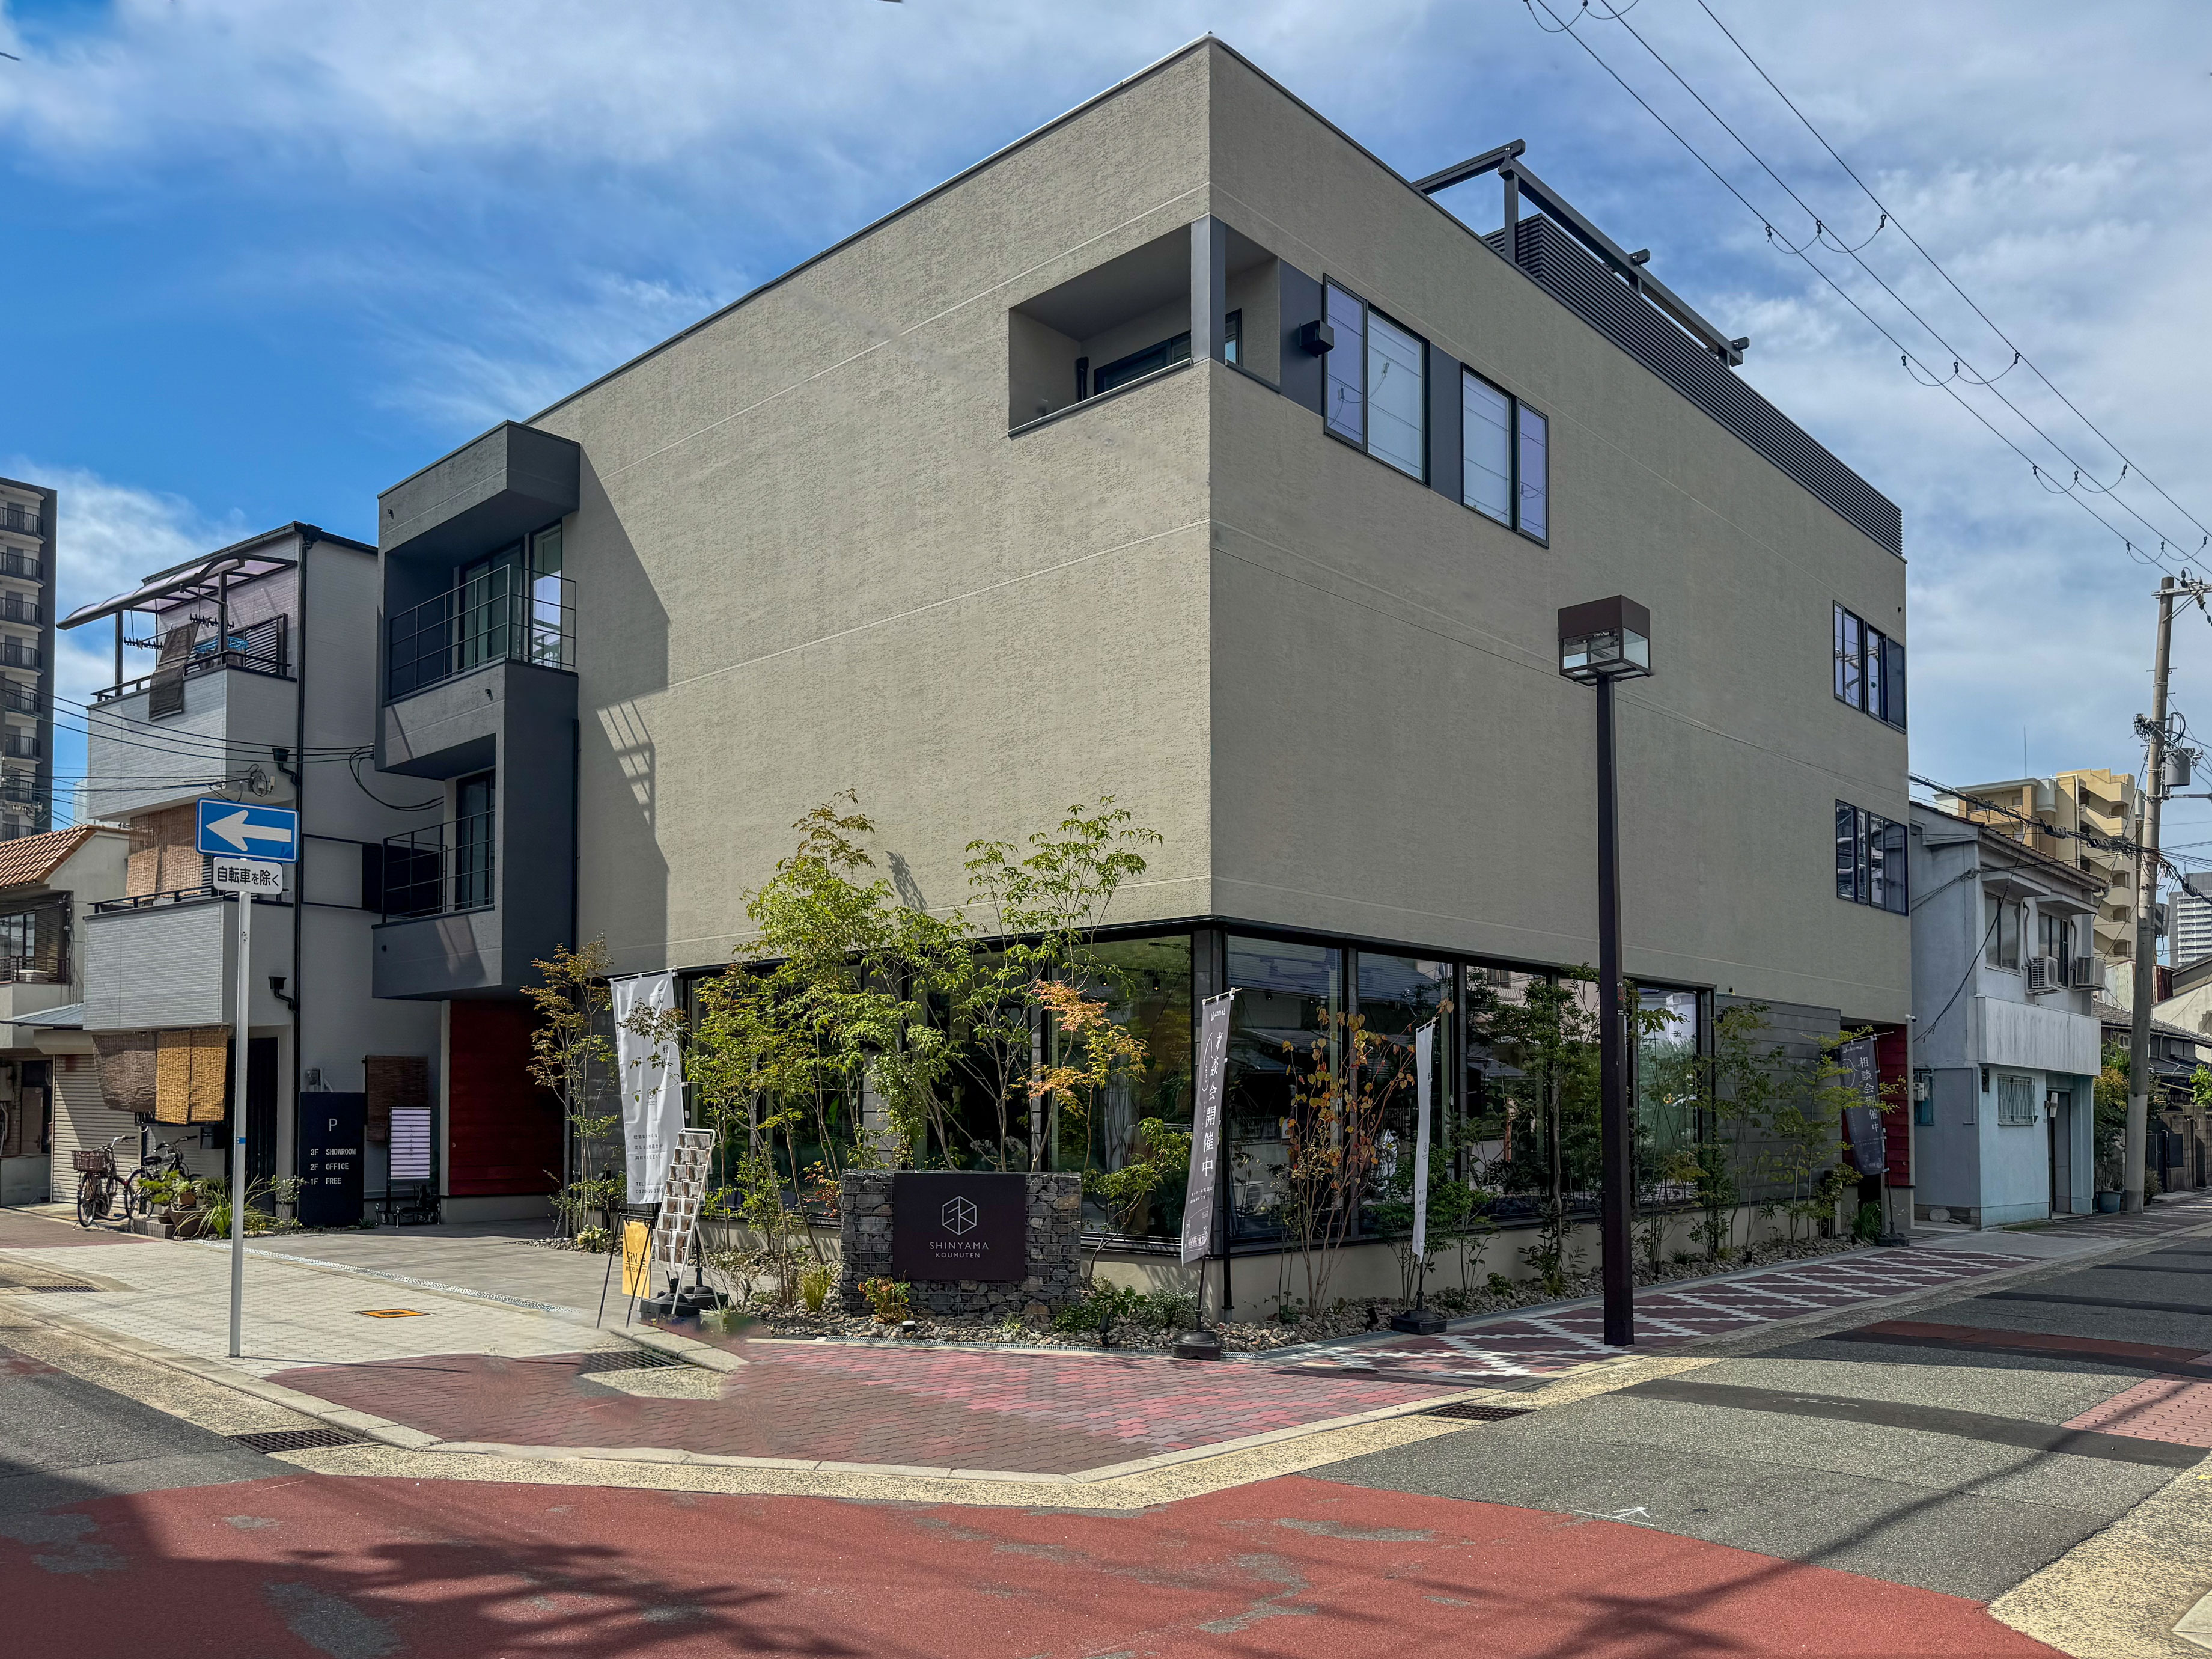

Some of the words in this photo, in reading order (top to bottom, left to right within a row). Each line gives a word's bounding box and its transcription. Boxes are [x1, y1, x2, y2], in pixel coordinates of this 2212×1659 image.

[217, 866, 279, 887] 自転車を除く
[329, 1118, 338, 1131] P
[929, 1241, 989, 1250] SHINYAMA
